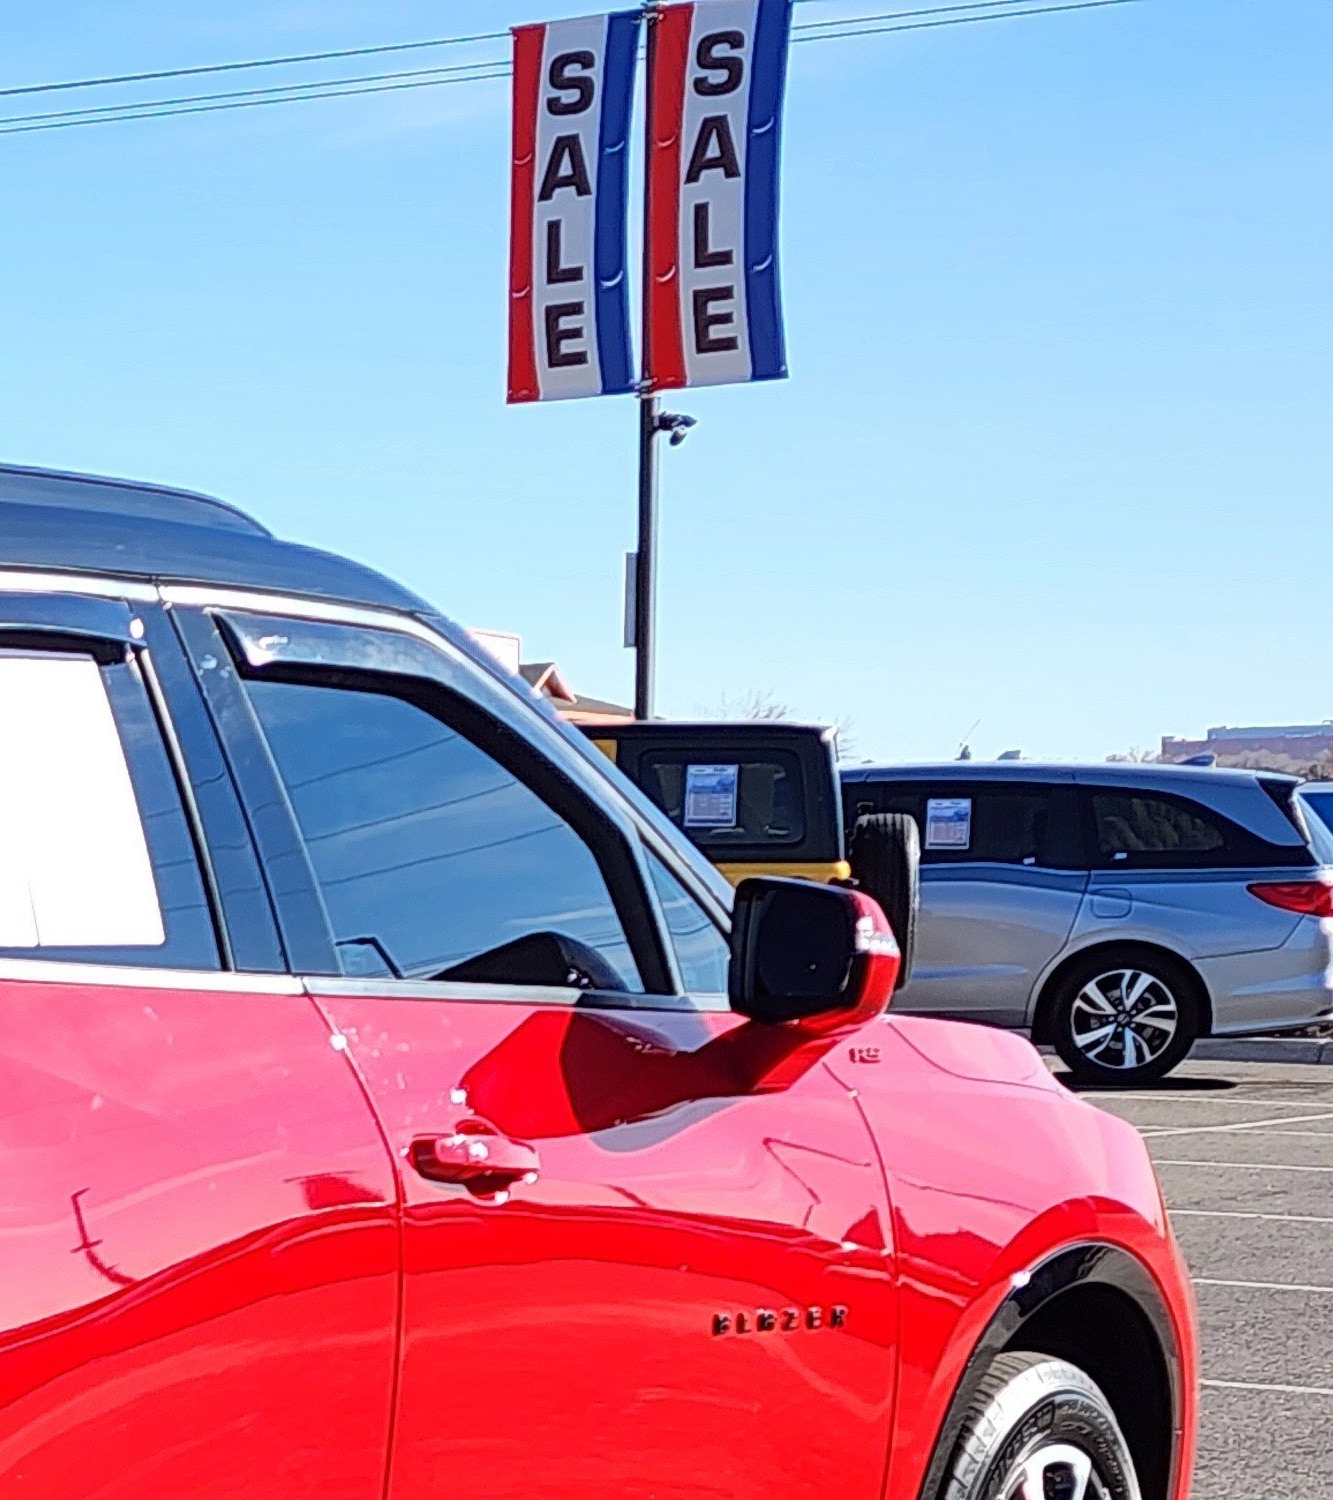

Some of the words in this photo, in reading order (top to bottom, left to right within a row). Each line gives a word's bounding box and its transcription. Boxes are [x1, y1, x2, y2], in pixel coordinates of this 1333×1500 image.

[537, 50, 595, 368] SALE
[684, 30, 745, 354] SALE
[712, 1305, 848, 1336] BLAZER
